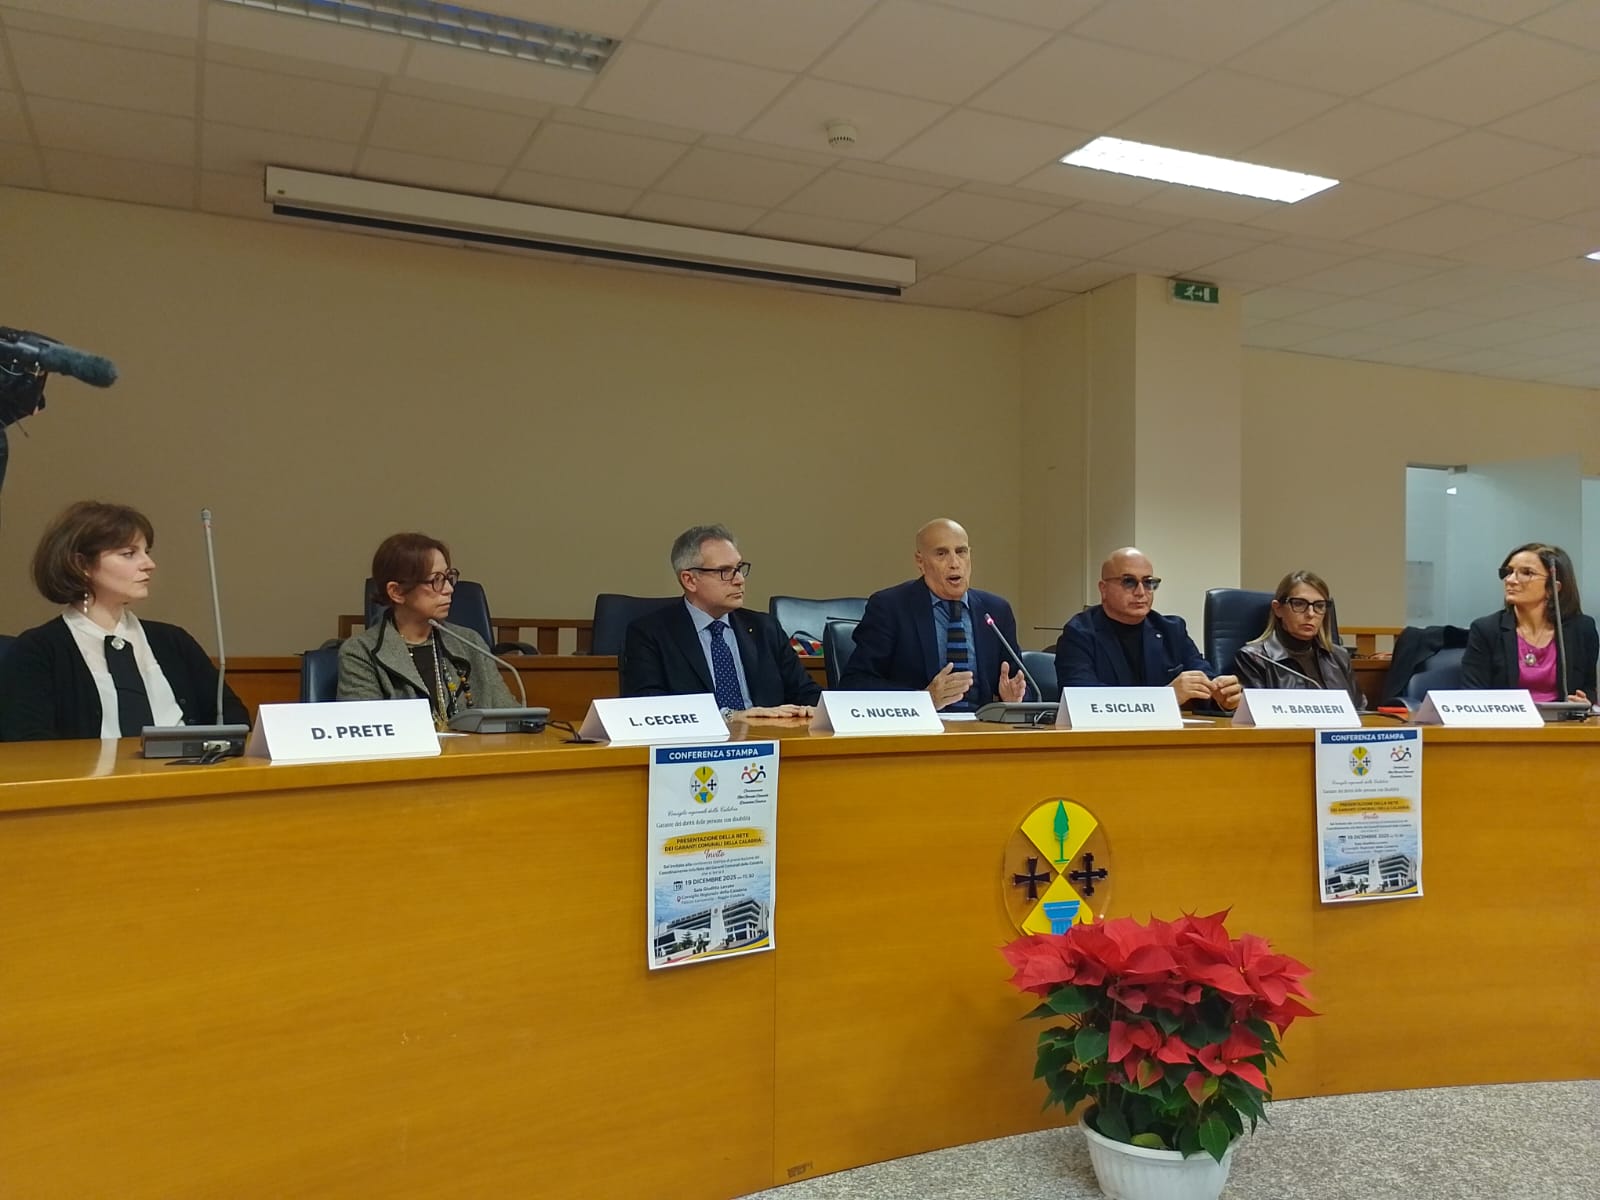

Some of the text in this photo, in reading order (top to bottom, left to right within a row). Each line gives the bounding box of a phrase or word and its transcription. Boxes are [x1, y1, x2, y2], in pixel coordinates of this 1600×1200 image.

[851, 708, 920, 718] C. NUCERA
[1090, 704, 1155, 713] E. SICLARI
[1272, 705, 1344, 714] M. BARBIERI
[1441, 704, 1527, 713] G. POLLIFRONE
[629, 713, 700, 727] L. CECERE
[311, 724, 395, 740] D. PRETE
[669, 748, 758, 760] CONFERENZA STAMPA
